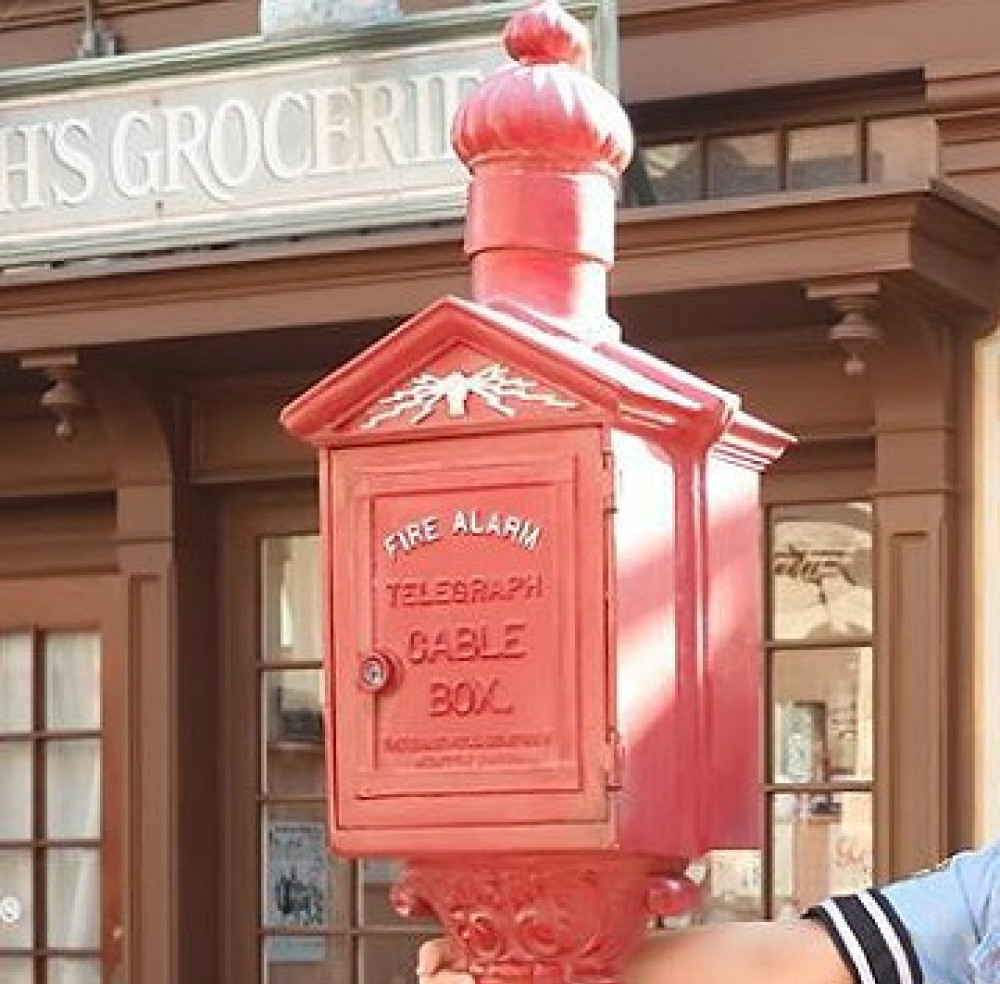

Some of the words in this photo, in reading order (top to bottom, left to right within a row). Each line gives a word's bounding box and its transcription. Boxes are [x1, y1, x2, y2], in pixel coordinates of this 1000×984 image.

[383, 517, 441, 559] FIRE
[452, 509, 544, 553] ALARM
[385, 574, 545, 609] TELEGRAPH
[407, 624, 528, 665] CABLE
